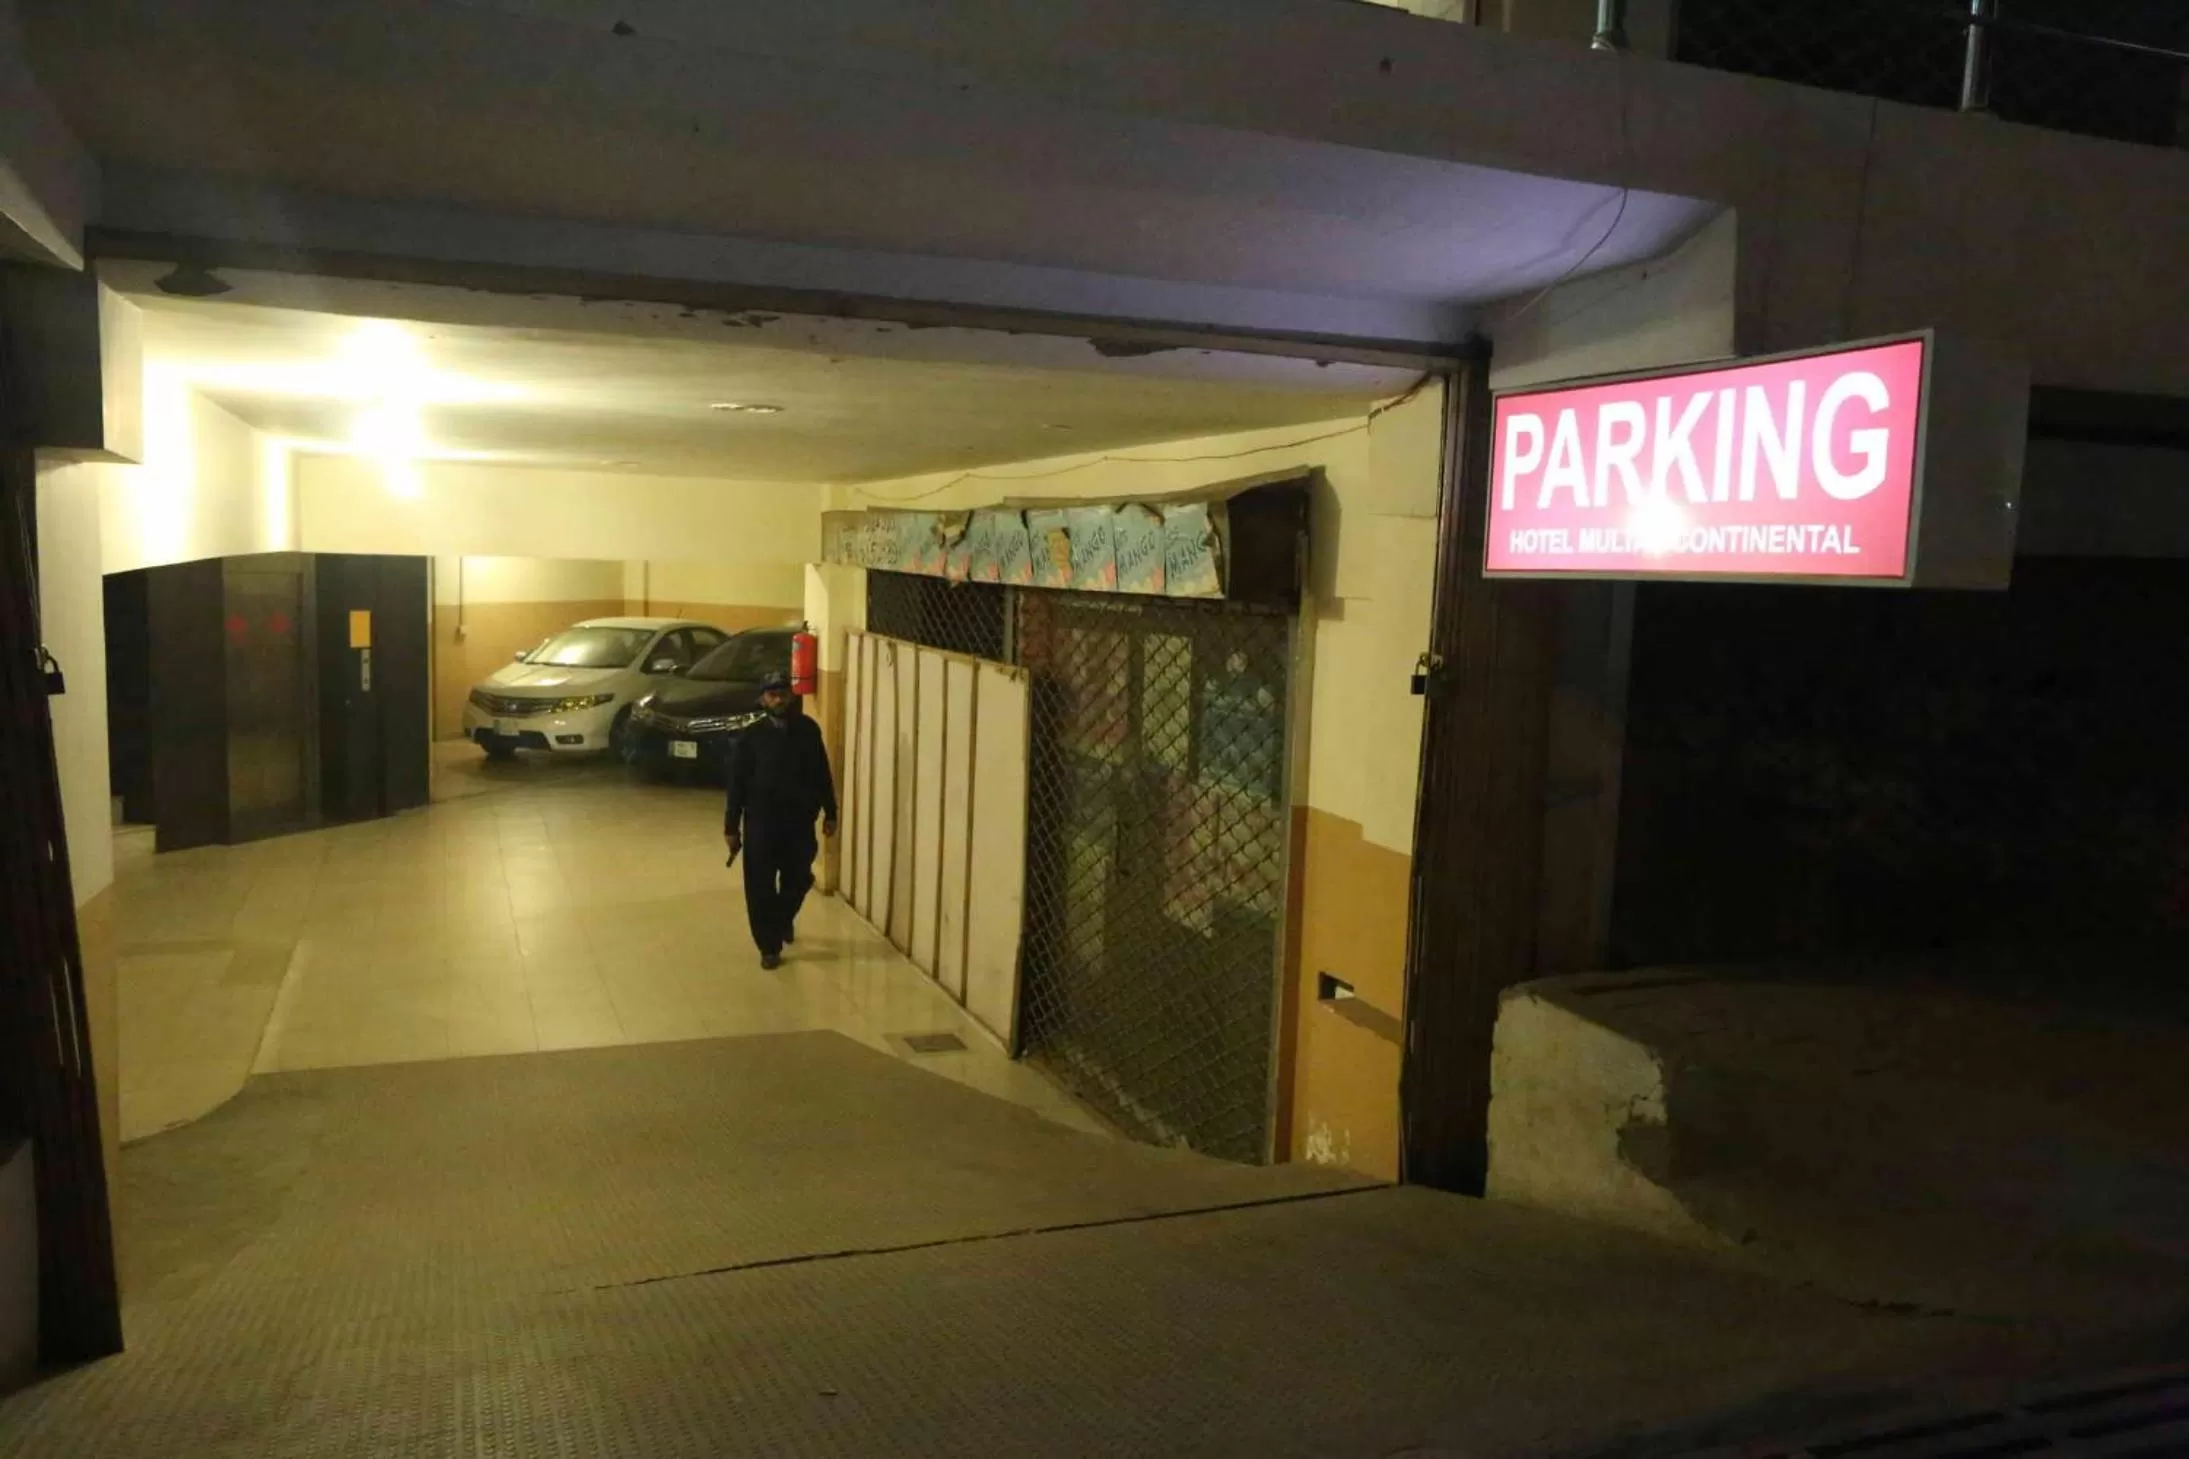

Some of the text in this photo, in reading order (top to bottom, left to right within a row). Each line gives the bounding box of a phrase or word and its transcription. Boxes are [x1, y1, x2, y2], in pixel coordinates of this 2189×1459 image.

[1502, 371, 1890, 511] PARKING
[1510, 529, 1574, 554] HOTEL
[1676, 524, 1861, 555] CONTINENTAL
